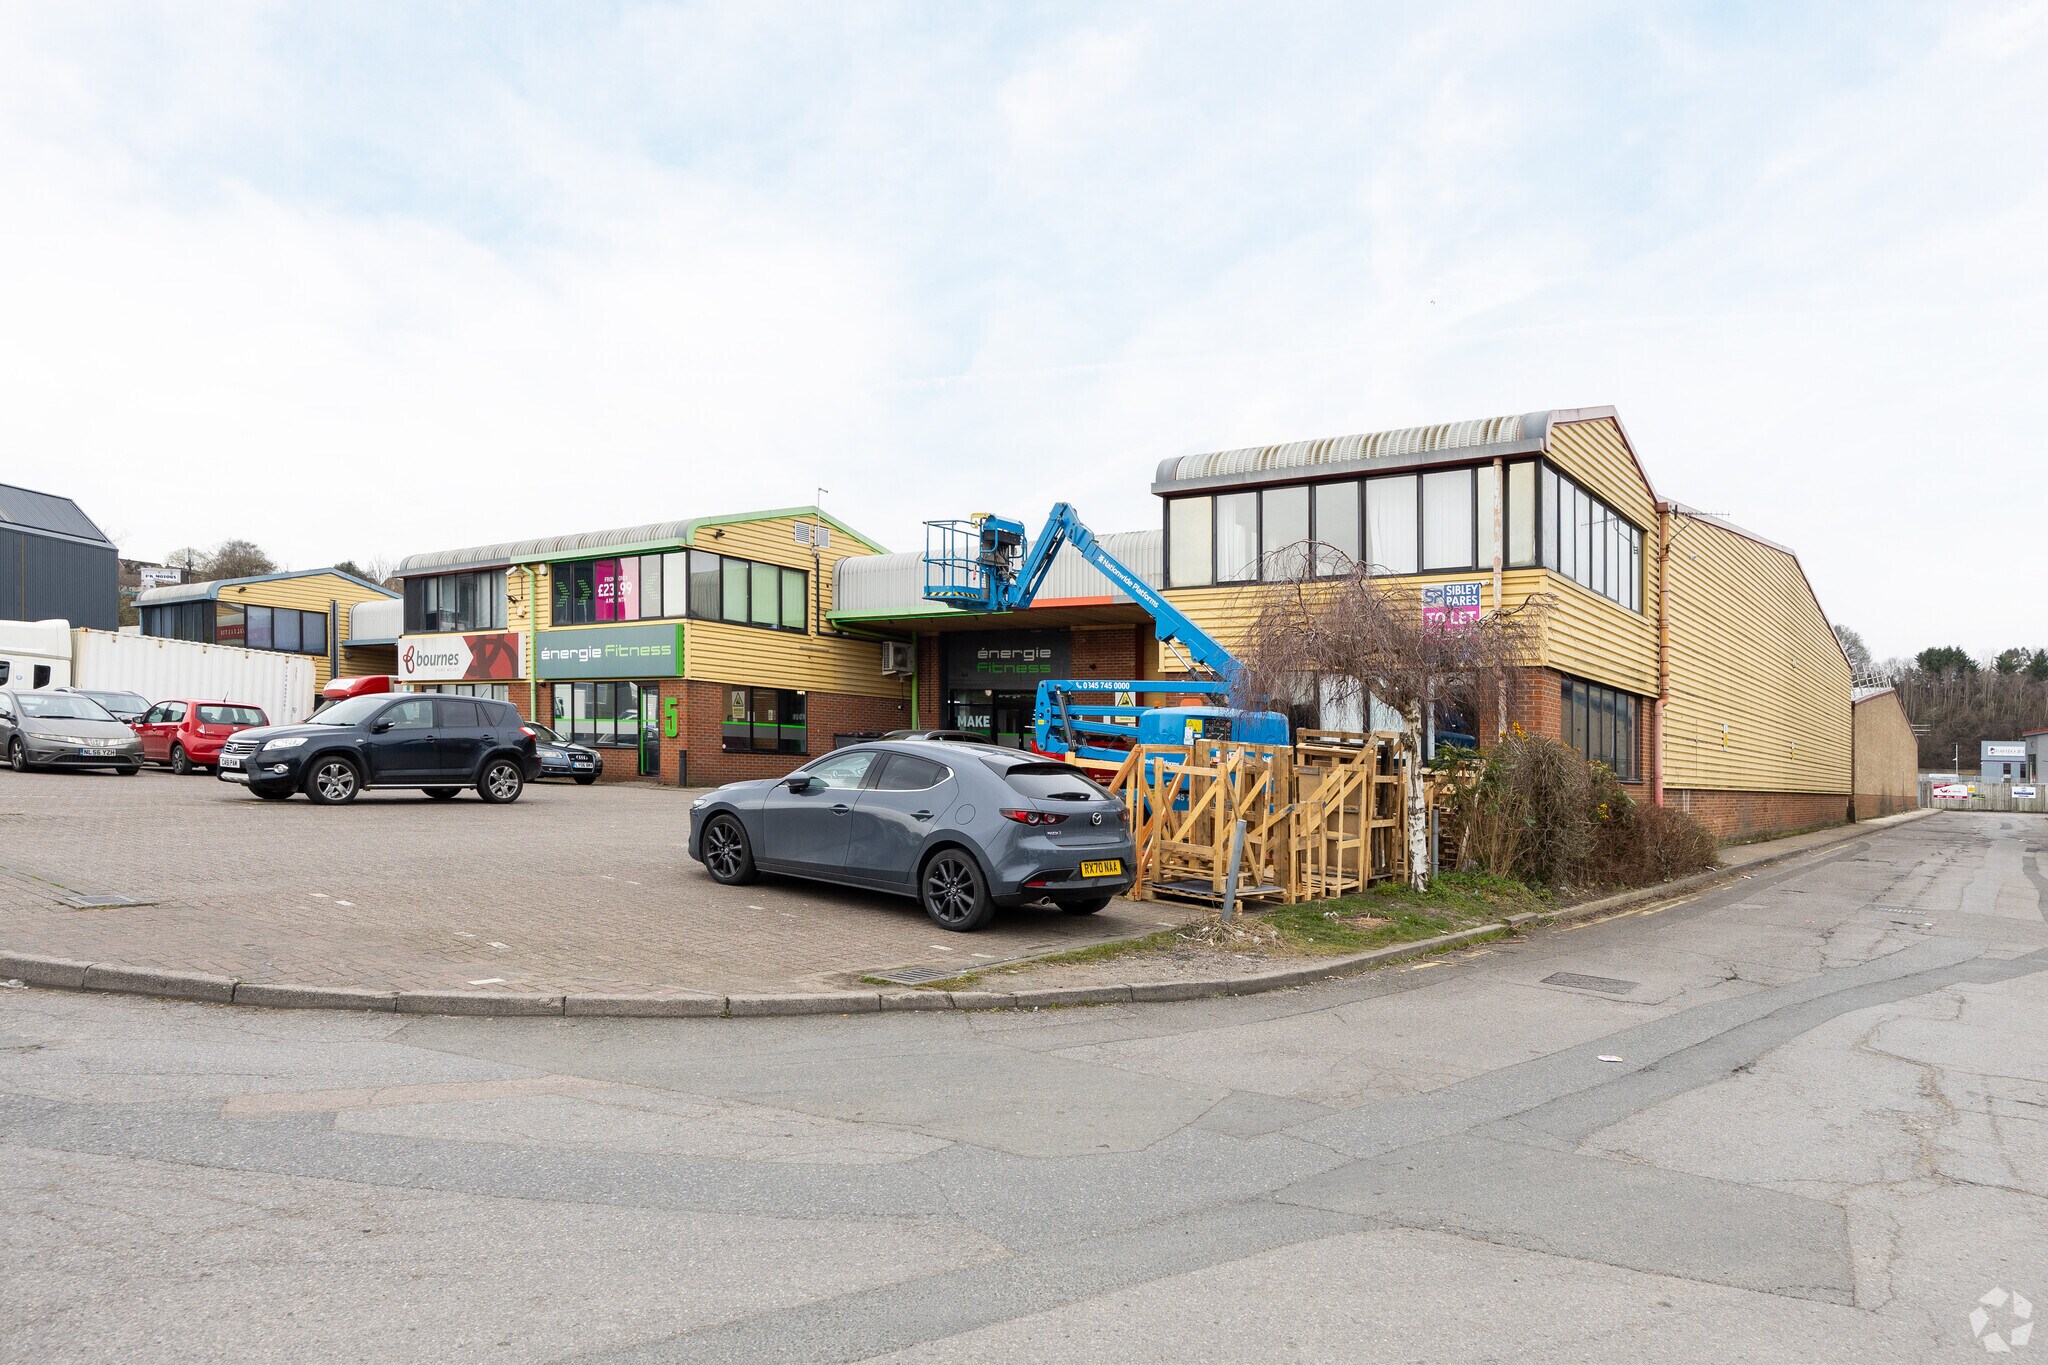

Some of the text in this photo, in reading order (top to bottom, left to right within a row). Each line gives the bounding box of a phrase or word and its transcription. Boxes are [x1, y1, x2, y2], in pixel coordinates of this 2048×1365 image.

[598, 582, 632, 597] £23.99
[1102, 558, 1159, 608] Nationwide Platforms
[1446, 585, 1478, 596] SIBLEY
[1446, 596, 1478, 606] PARES
[1426, 611, 1476, 625] TO LET
[416, 650, 459, 666] bournes
[541, 646, 602, 662] énergie
[978, 648, 1051, 661] énergie
[664, 697, 678, 737] 5
[958, 716, 990, 728] MAKE
[1084, 862, 1118, 874] RX70 NAA
